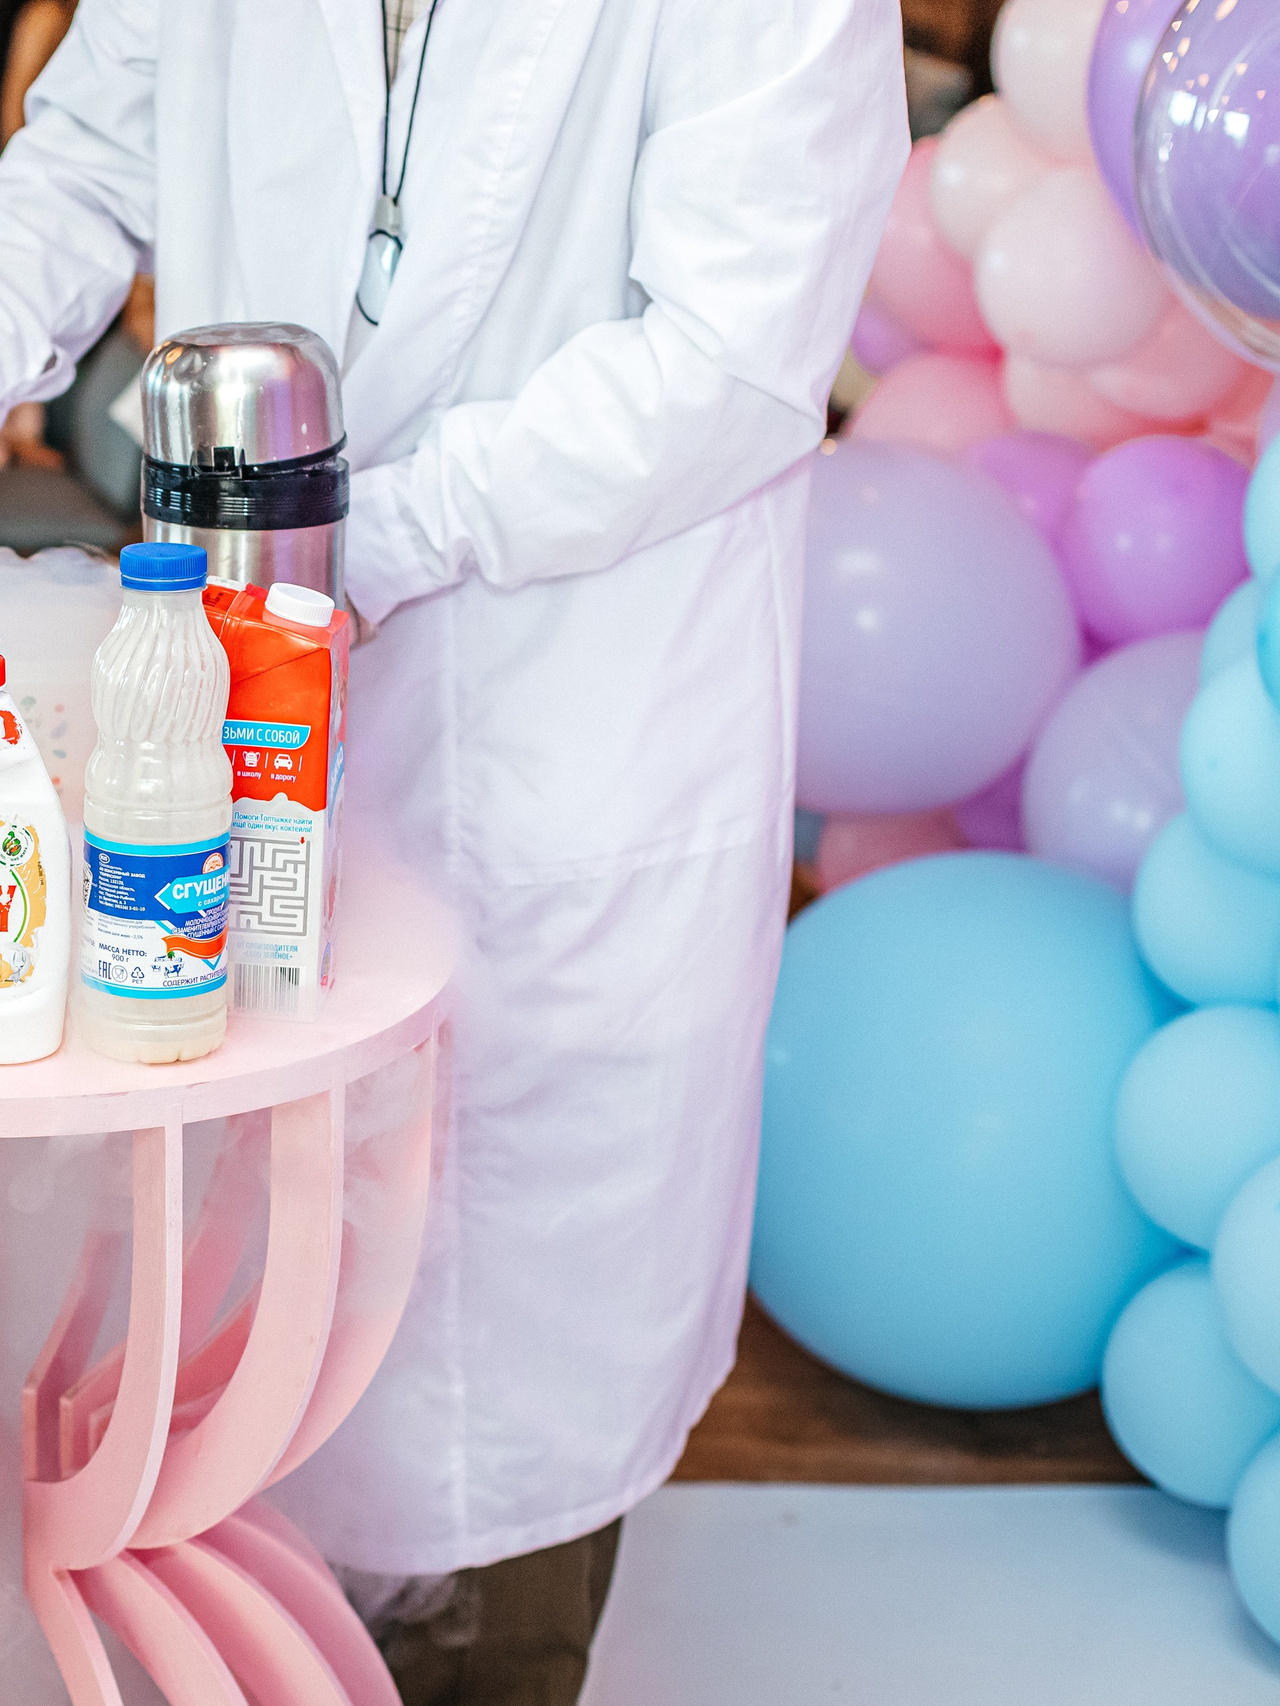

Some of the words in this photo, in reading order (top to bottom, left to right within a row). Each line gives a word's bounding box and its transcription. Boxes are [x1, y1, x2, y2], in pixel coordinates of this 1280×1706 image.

[256, 728, 263, 741] С
[265, 729, 300, 744] СОБОЙ
[241, 771, 262, 780] школу
[275, 774, 296, 783] дорогу
[234, 812, 259, 821] Помоги
[260, 814, 292, 824] Топтыжке
[247, 823, 263, 831] один
[264, 824, 279, 833] вкус
[280, 825, 313, 833] коктейля!
[99, 943, 120, 954] МАССА
[122, 948, 147, 957] НЕТТО:
[111, 954, 124, 962] 900
[162, 976, 199, 987] СОДЕРЖИТ
